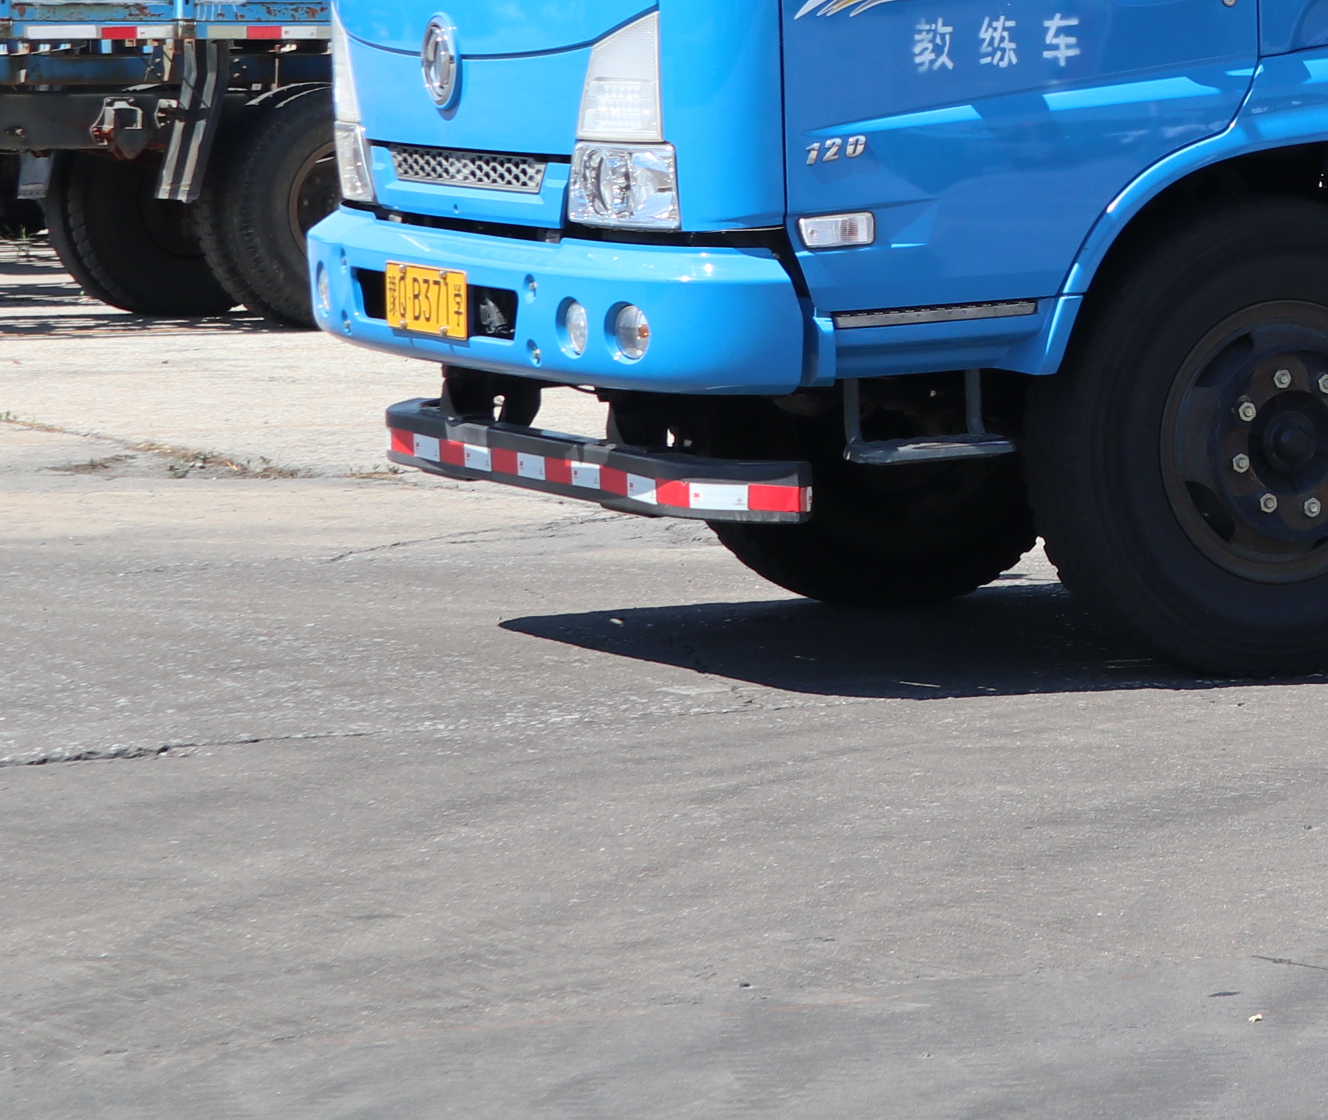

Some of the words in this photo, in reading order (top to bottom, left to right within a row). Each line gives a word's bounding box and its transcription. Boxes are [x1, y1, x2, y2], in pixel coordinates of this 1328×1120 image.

[912, 13, 1080, 72] 教练车
[806, 135, 866, 165] 120
